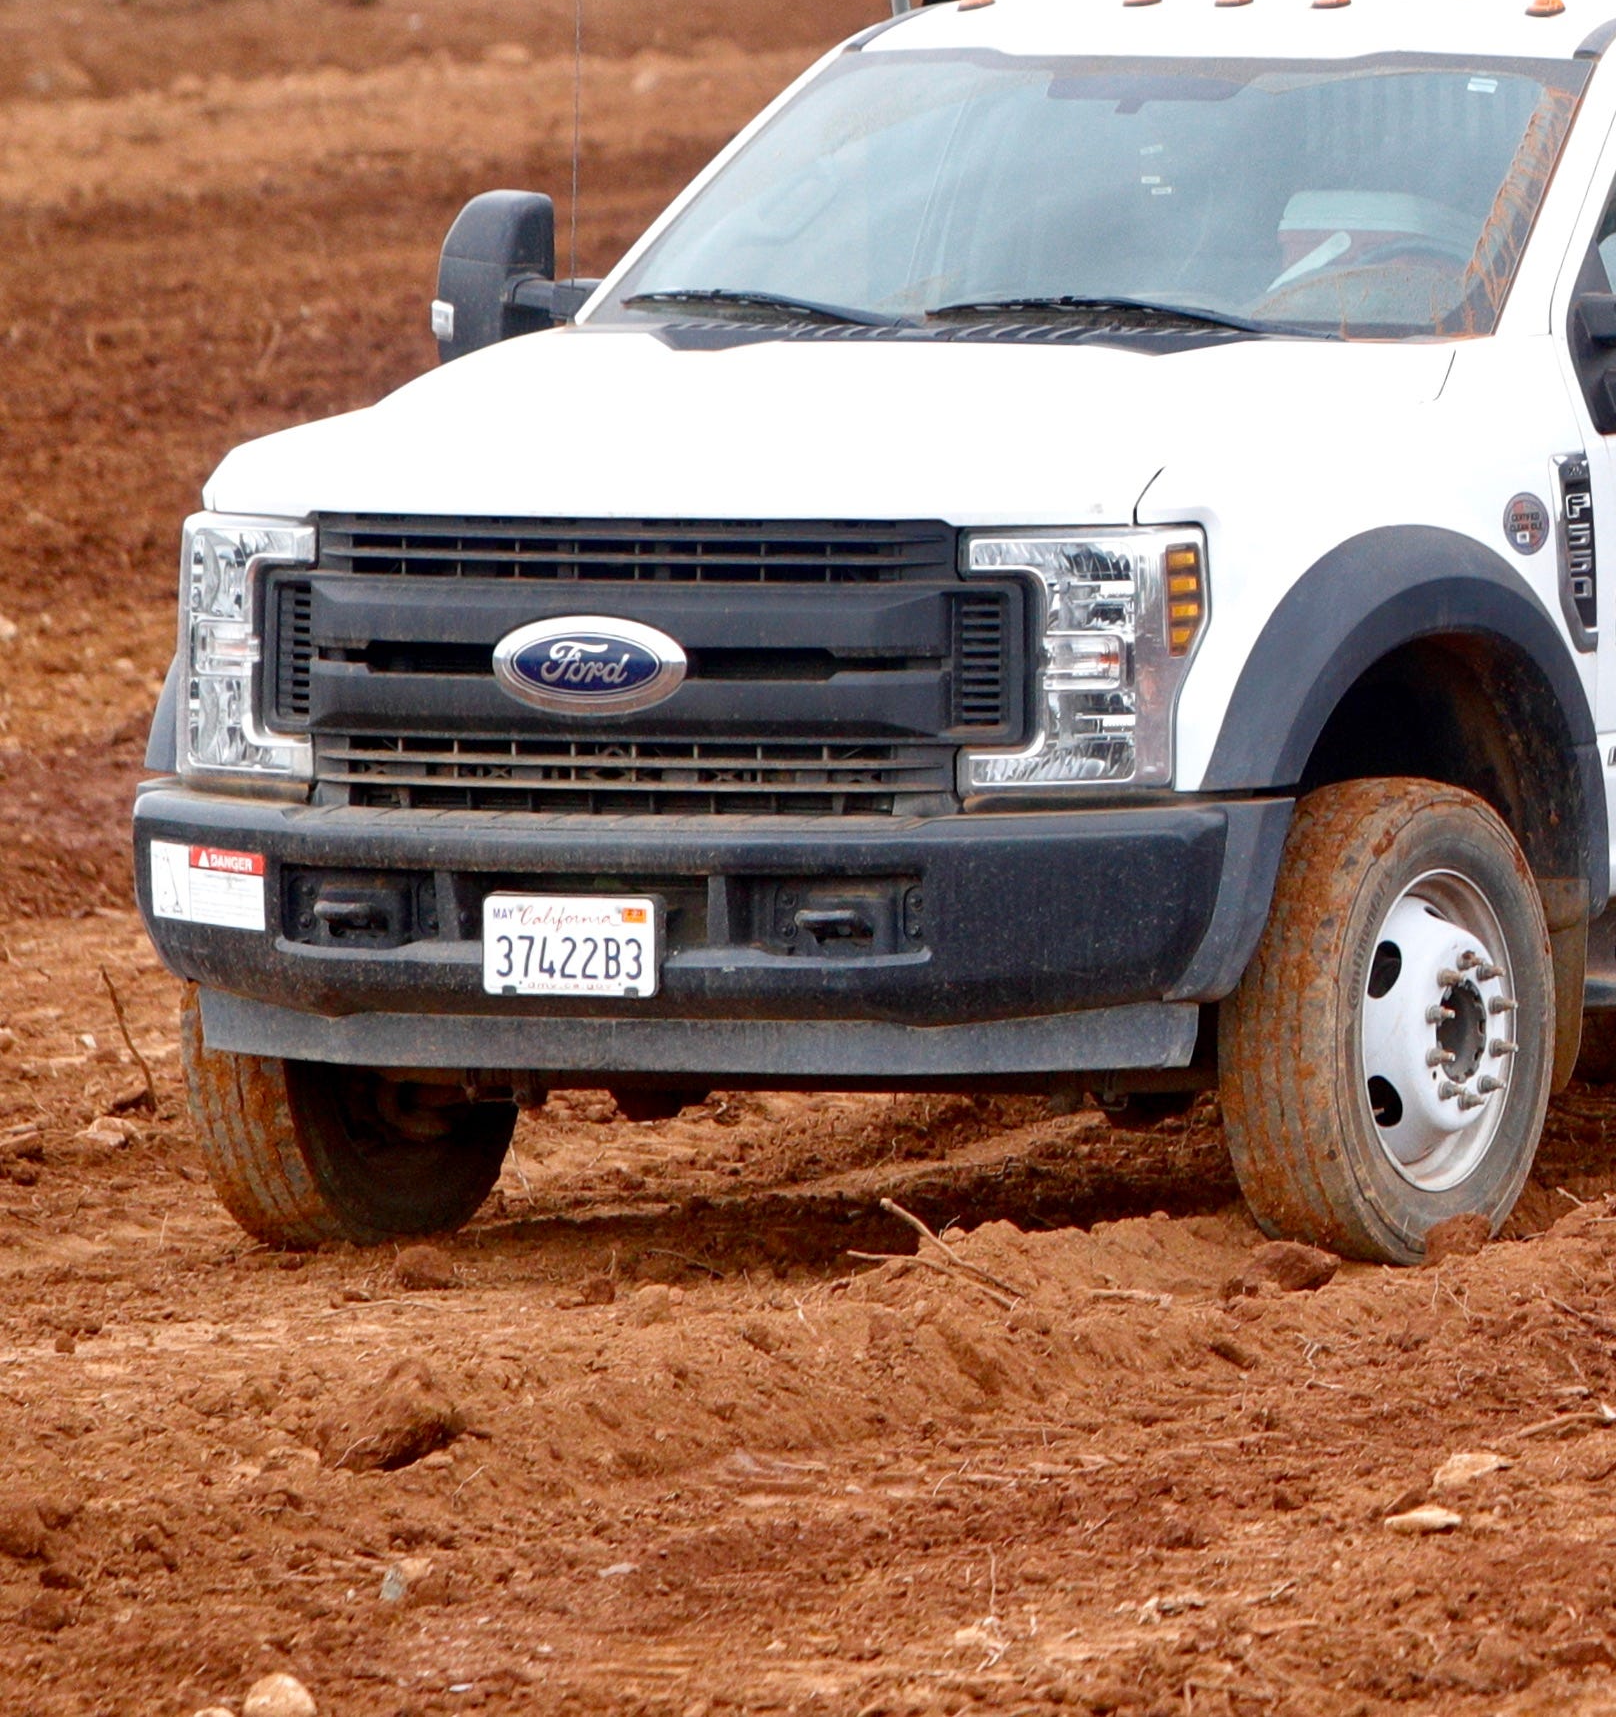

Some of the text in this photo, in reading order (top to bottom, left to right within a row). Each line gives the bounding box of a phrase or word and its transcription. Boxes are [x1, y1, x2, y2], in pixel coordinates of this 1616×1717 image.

[541, 641, 630, 684] Ford
[210, 853, 253, 872] DANGER
[493, 908, 514, 920] MAY
[520, 905, 621, 932] California
[496, 935, 642, 980] 37422B3
